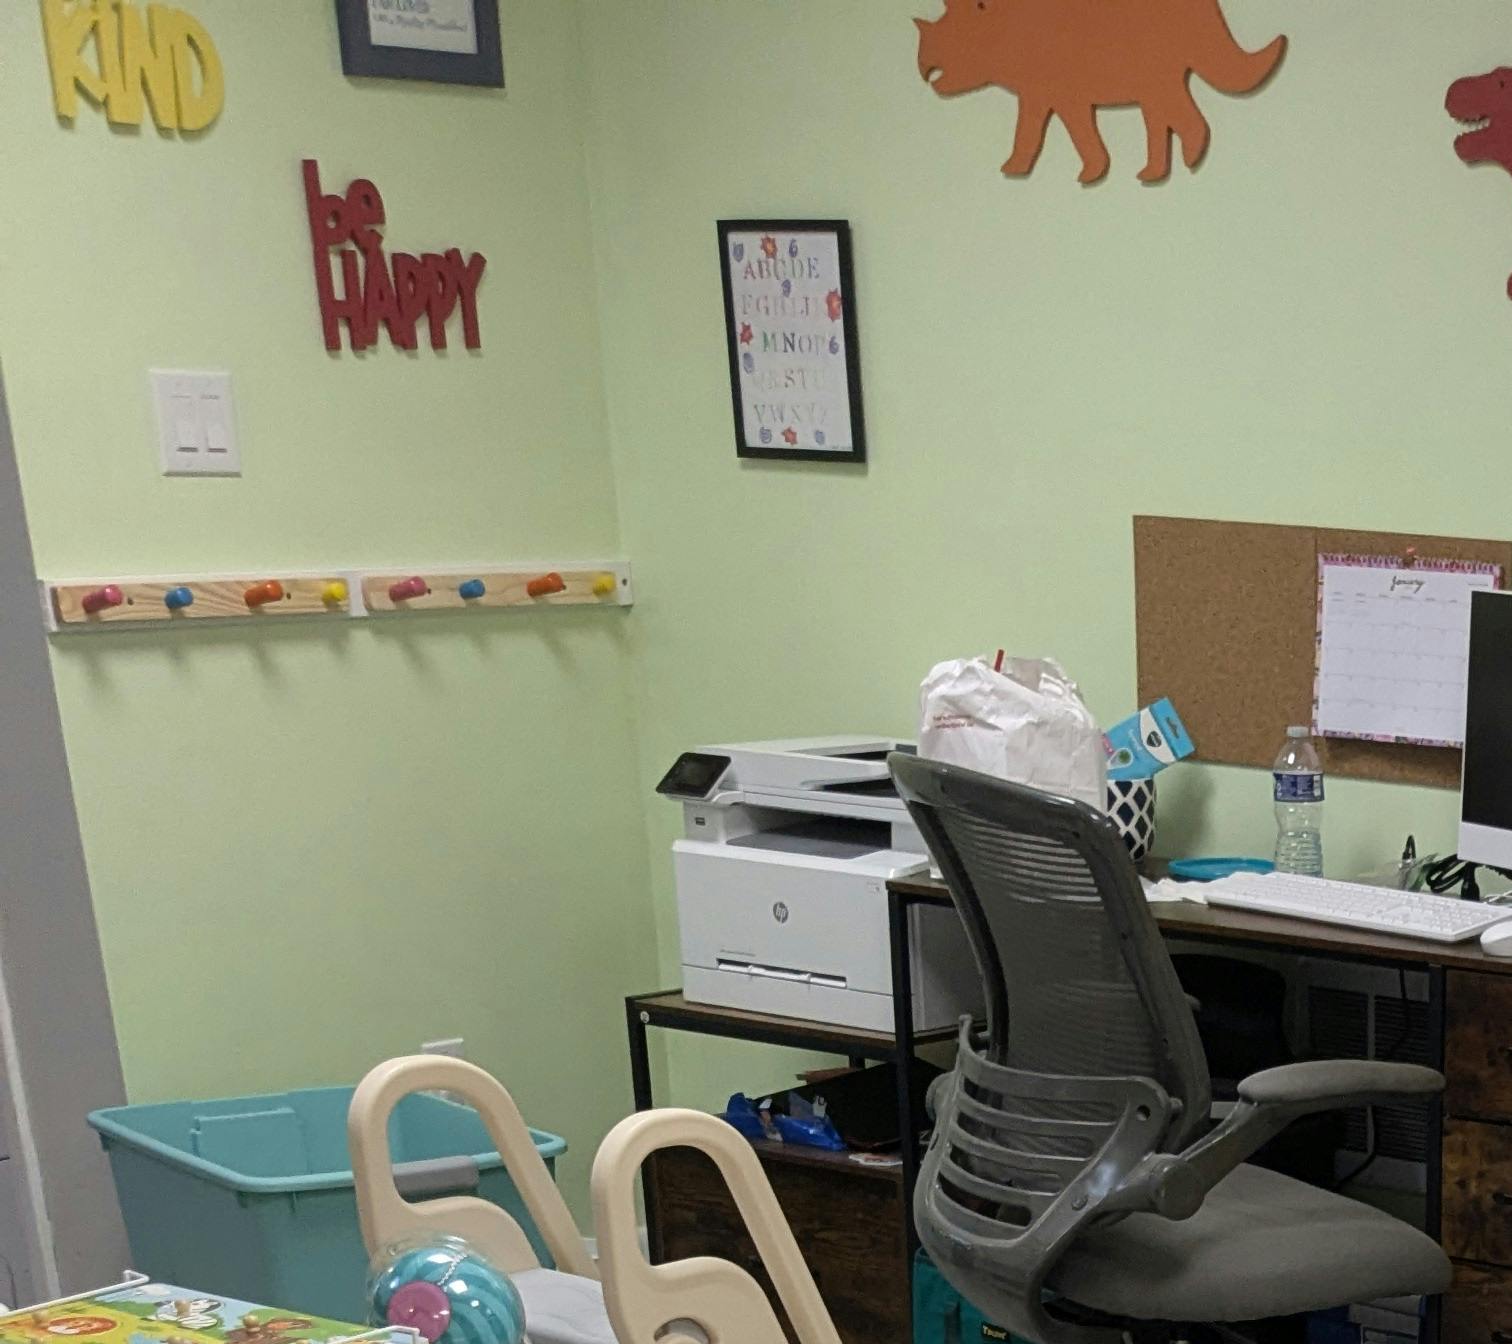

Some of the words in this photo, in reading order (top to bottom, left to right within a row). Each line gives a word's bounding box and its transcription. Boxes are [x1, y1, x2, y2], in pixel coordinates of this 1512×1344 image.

[40, 0, 225, 131] KIND
[302, 159, 385, 248] be
[315, 230, 487, 351] HAPPY
